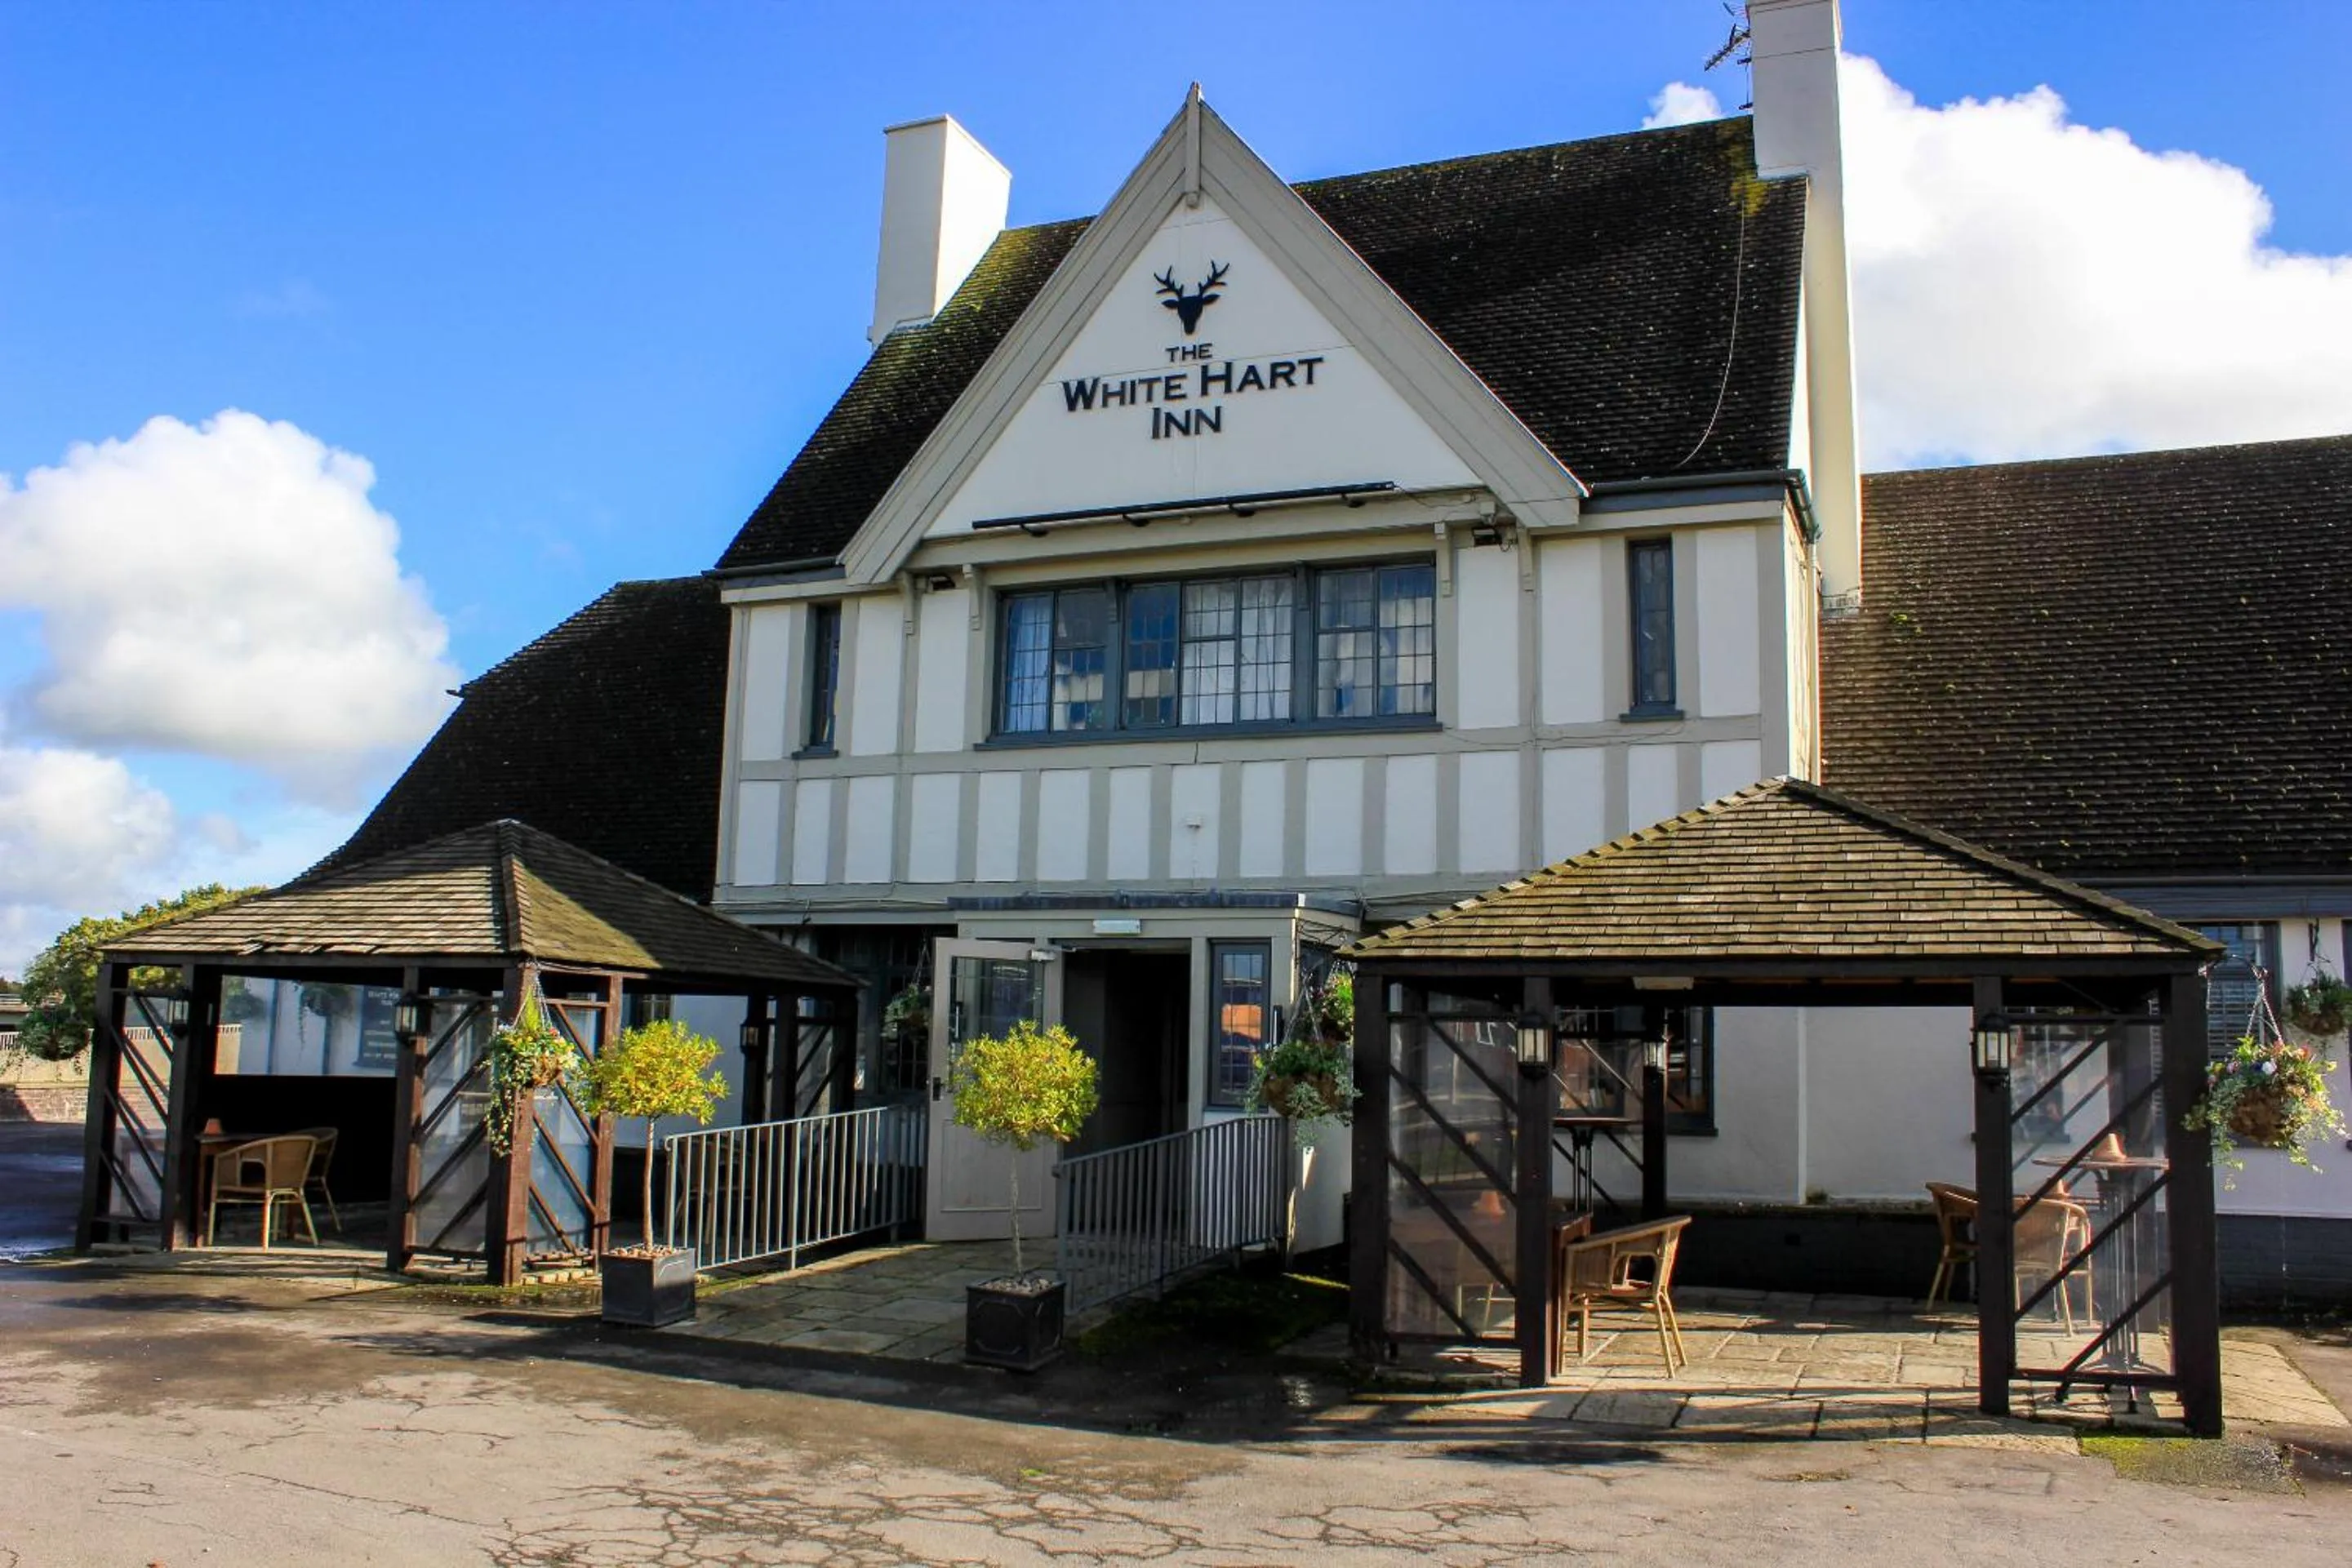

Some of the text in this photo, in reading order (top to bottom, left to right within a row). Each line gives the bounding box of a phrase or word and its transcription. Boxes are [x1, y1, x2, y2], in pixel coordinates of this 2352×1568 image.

[1165, 343, 1213, 363] THE
[1062, 357, 1324, 412] WHITE HART
[1151, 405, 1222, 440] INN
